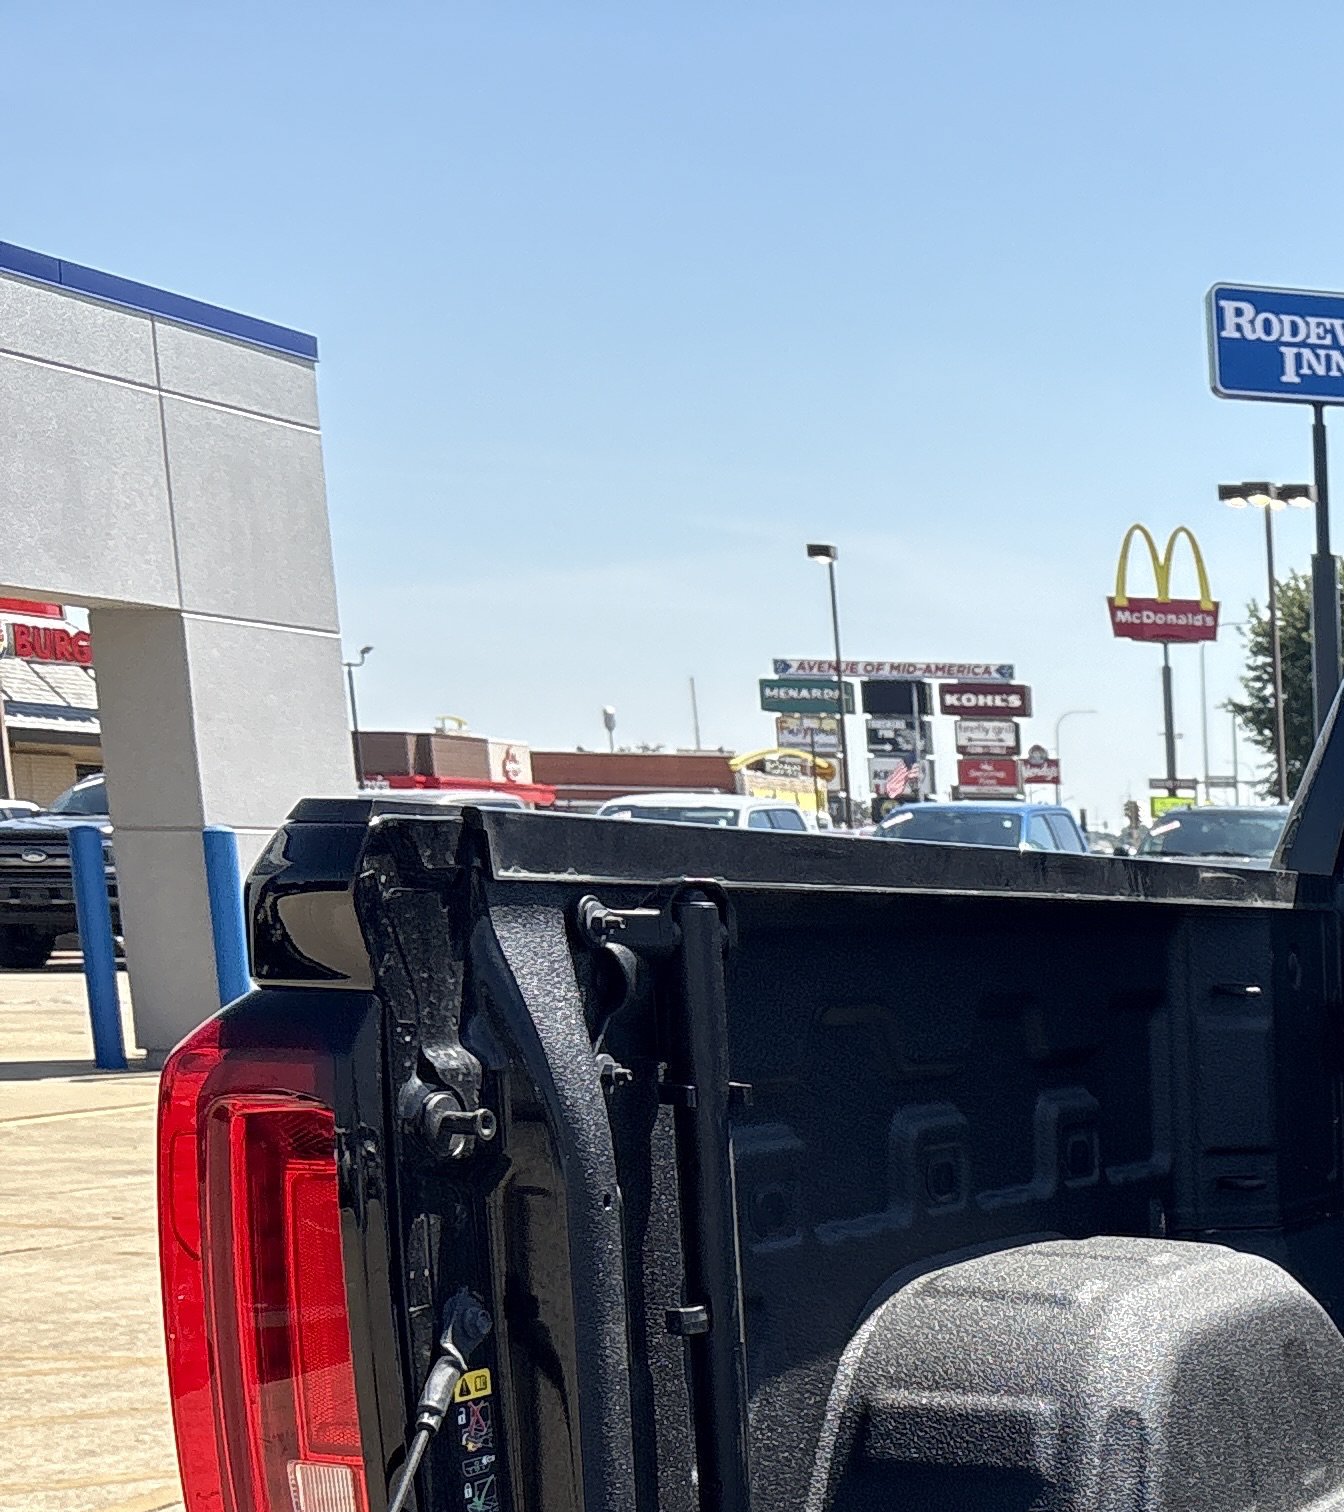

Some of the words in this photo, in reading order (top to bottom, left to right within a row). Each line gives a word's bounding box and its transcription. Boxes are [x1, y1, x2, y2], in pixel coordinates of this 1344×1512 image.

[1114, 610, 1215, 627] McDonald's
[863, 662, 884, 675] OF
[889, 663, 993, 676] MID-AMERICA
[944, 692, 1022, 708] KOHL'S
